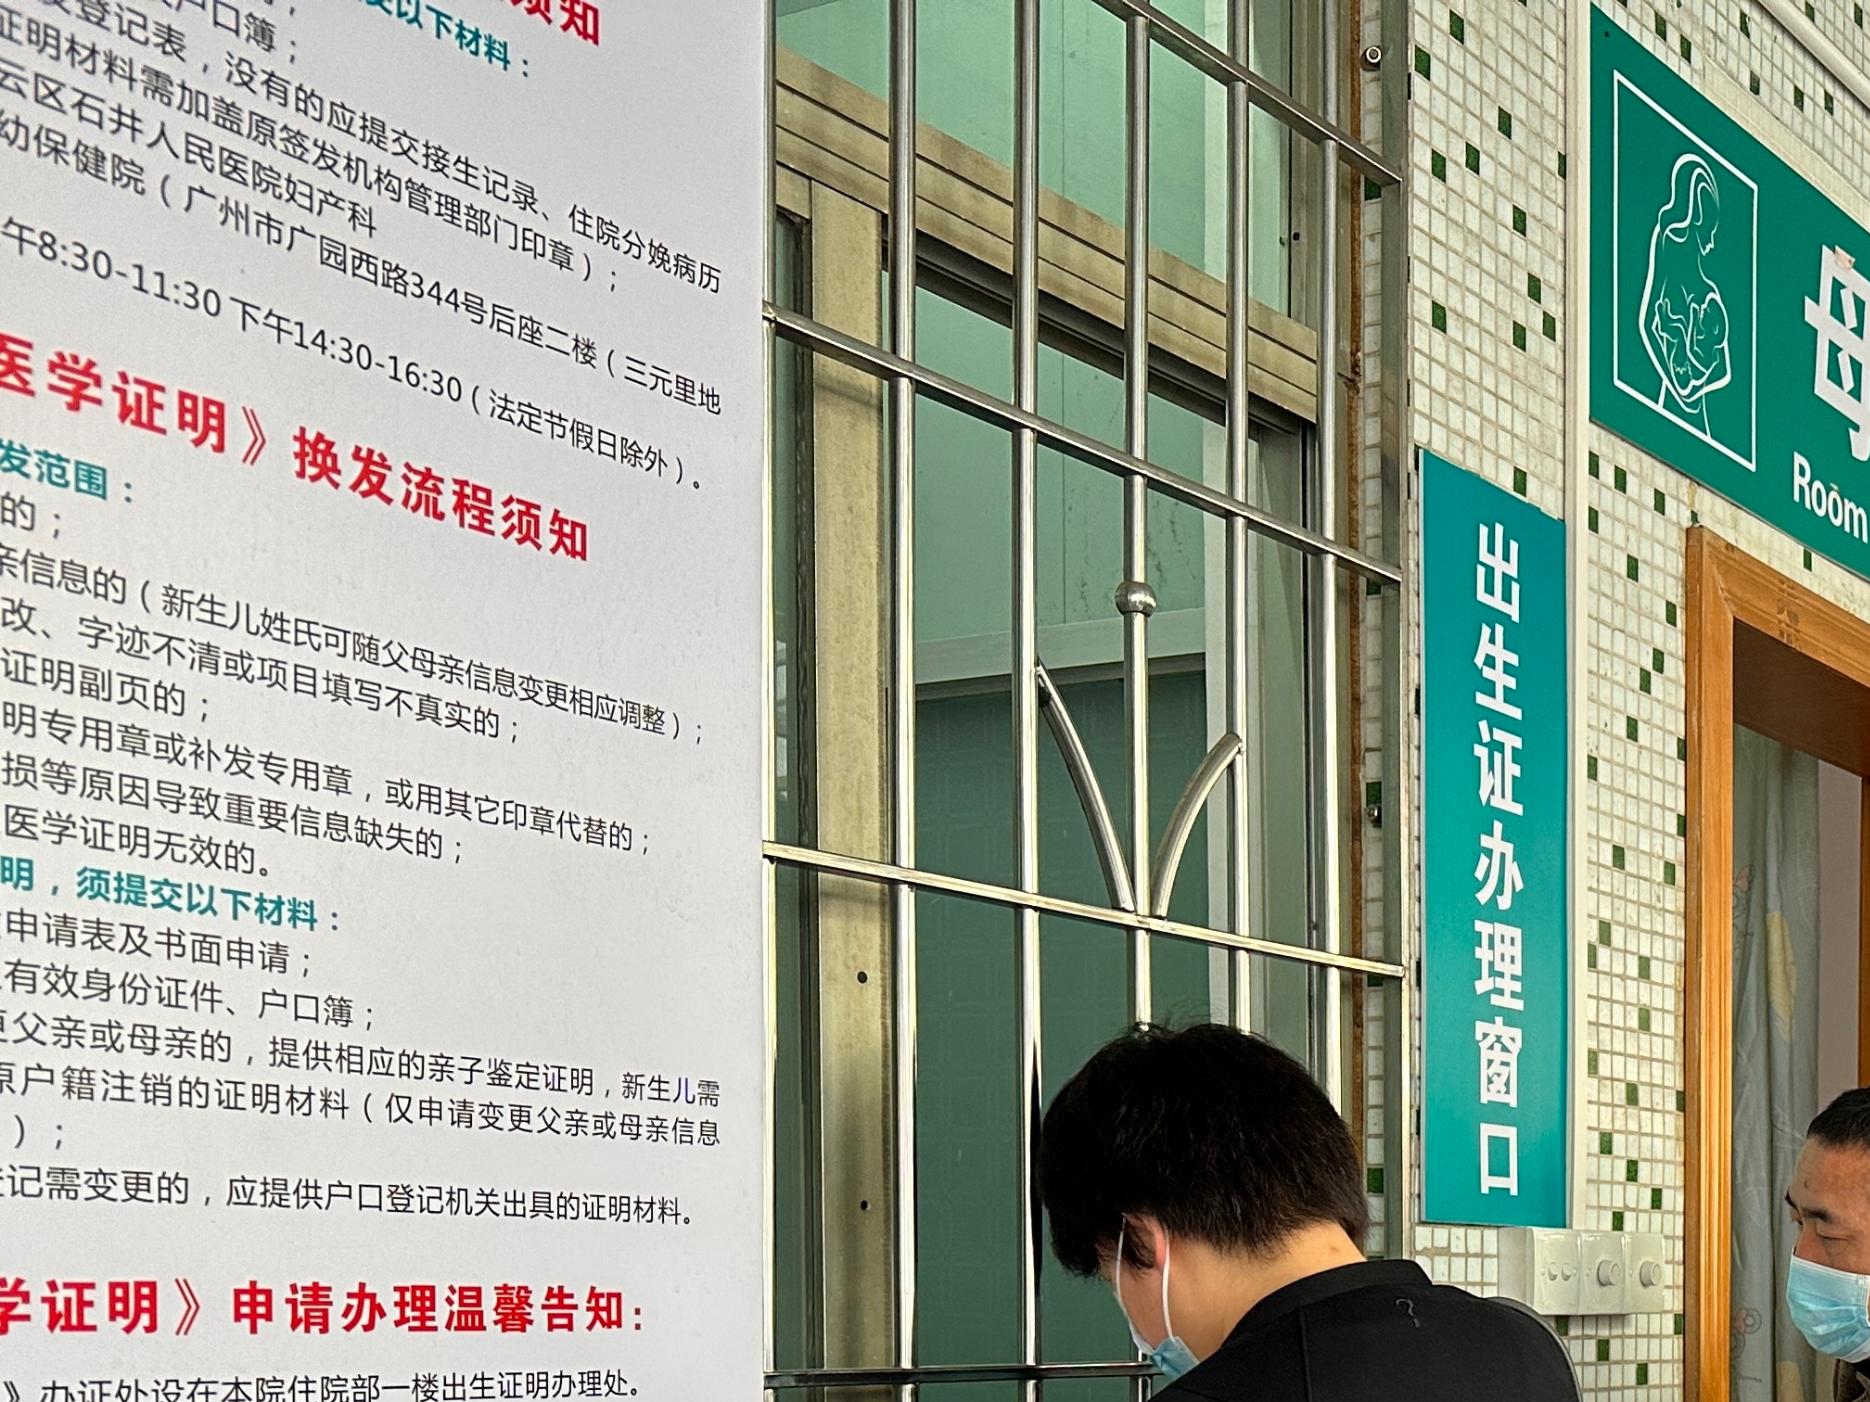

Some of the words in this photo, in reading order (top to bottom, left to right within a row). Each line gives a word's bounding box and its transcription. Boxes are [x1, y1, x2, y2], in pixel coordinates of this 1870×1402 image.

[0, 438, 132, 503] 发范围：
[1793, 450, 1868, 544] Room
[1, 491, 60, 539] 的；
[5, 804, 268, 878] 医学证明无效的。
[1473, 520, 1525, 1199] 出生证办理窗口
[0, 1009, 721, 1107] 父亲或母亲的，提供相应的亲子鉴定证明，新生儿需
[0, 1163, 690, 1226] 记需变更的，应提供户口登记机关出具的证明材料。
